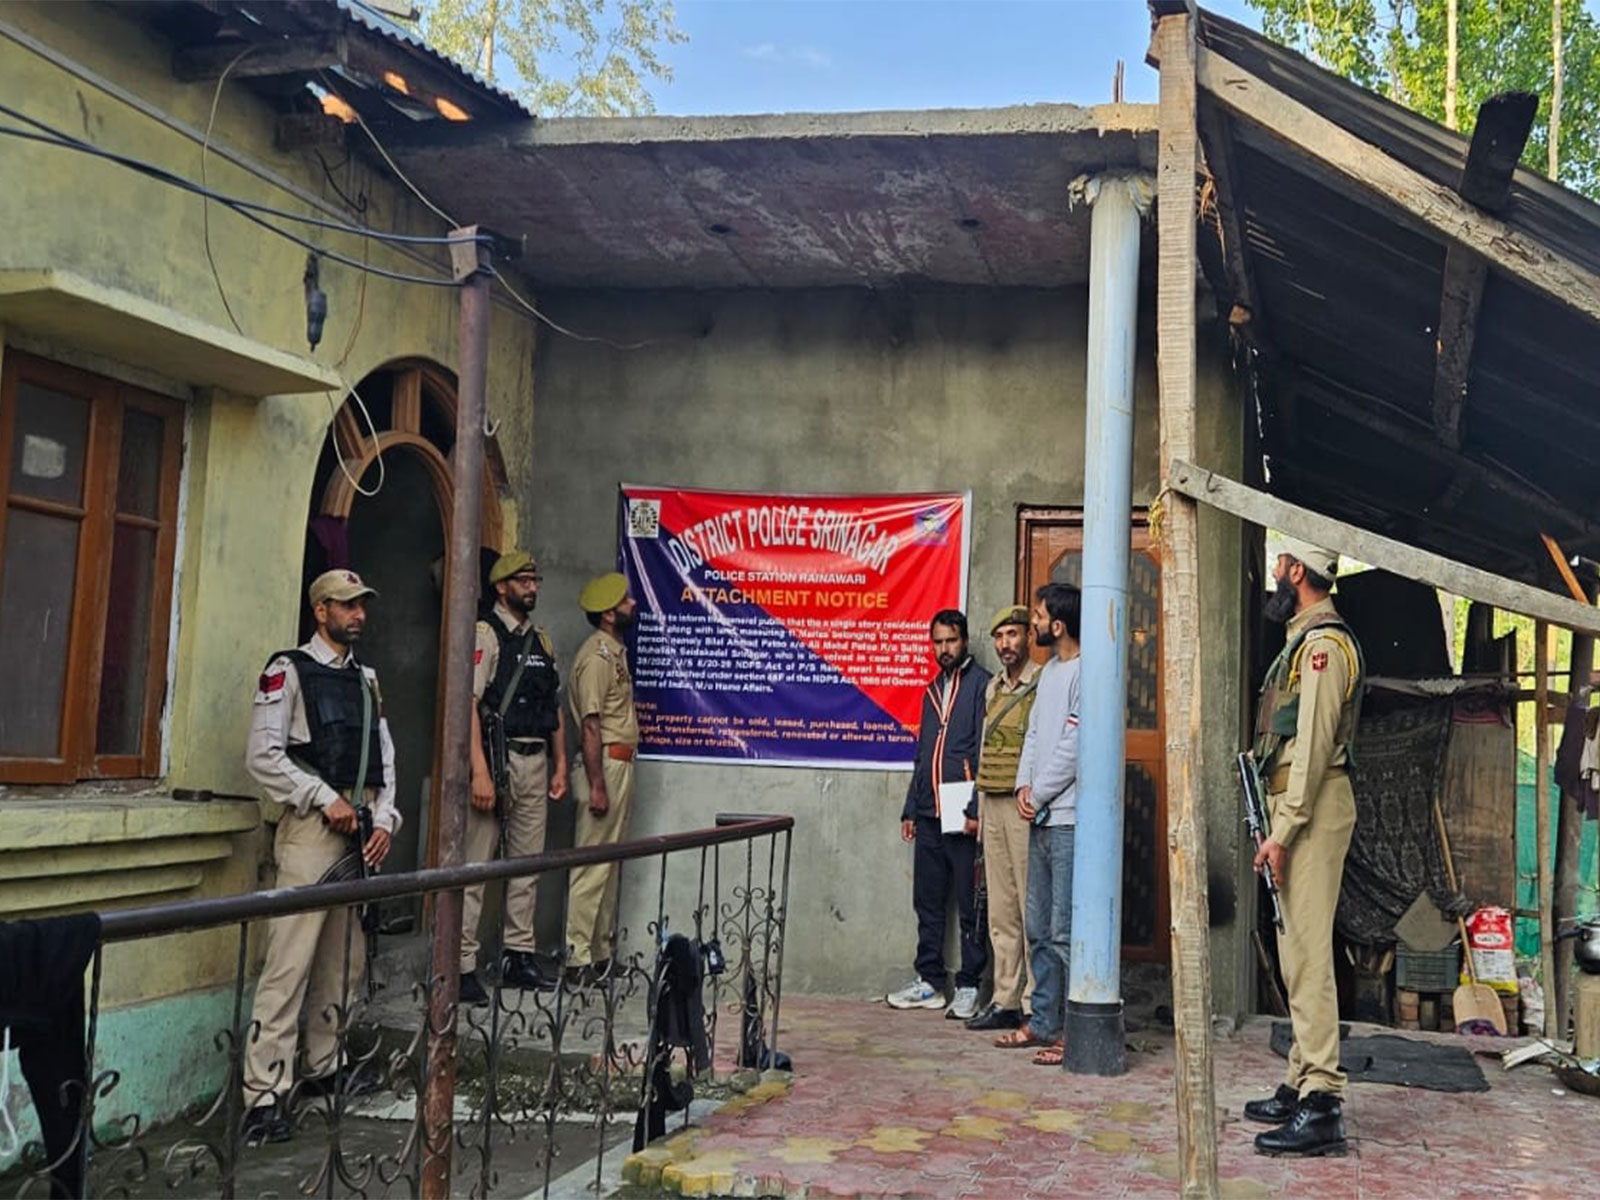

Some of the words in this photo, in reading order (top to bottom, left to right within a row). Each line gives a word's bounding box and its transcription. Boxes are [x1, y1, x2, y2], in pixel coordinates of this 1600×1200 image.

[668, 508, 745, 574] DISTRICT
[747, 504, 810, 548] POLICE
[810, 508, 900, 576] SRINAGAR
[704, 569, 747, 582] POLICE
[747, 571, 798, 583] STATION
[799, 573, 866, 585] RAINAWARI
[681, 586, 811, 606] ATTACHMENT
[815, 590, 889, 609] NOTICE
[668, 613, 677, 622] to
[679, 613, 706, 623] inform
[787, 618, 804, 627] that
[806, 618, 822, 628] the
[830, 619, 856, 630] single
[858, 620, 882, 631] story
[883, 620, 931, 631] residential
[638, 623, 664, 633] house
[666, 625, 692, 635] along
[695, 625, 713, 635] with
[831, 631, 877, 642] belonging
[879, 631, 889, 641] to
[892, 632, 930, 642] accused
[637, 636, 668, 646] person
[669, 637, 702, 648] namely
[704, 637, 724, 647] Bilal
[807, 641, 820, 650] Ali
[822, 642, 849, 651] Mohd
[880, 643, 898, 653] R/o
[675, 658, 693, 668] U/S
[735, 660, 762, 670] NDPS
[764, 661, 782, 671] Act
[785, 662, 796, 671] of
[798, 663, 817, 672] P/S
[919, 665, 929, 675] is
[774, 651, 794, 660] who
[796, 652, 805, 660] is
[823, 652, 854, 662] volved
[856, 653, 866, 662] in
[868, 655, 891, 663] case
[893, 654, 911, 664] FIR
[913, 655, 930, 665] No.
[635, 668, 664, 679] hereby
[665, 669, 706, 680] attached
[706, 670, 733, 680] under
[734, 671, 766, 681] section
[785, 673, 796, 682] of
[796, 673, 811, 683] the
[812, 674, 839, 684] NDPS
[881, 676, 891, 686] of
[635, 680, 657, 688] ment
[658, 680, 667, 688] of
[695, 681, 714, 691] M/o
[715, 682, 741, 692] Home
[742, 682, 774, 693] Affairs.
[655, 714, 693, 724] property
[697, 716, 729, 726] cannot
[732, 716, 744, 726] be
[674, 737, 692, 746] size
[693, 738, 703, 746] or
[782, 731, 827, 740] renovated
[829, 733, 840, 741] or
[841, 732, 874, 742] altered
[876, 733, 886, 742] in
[888, 733, 914, 743] terms
